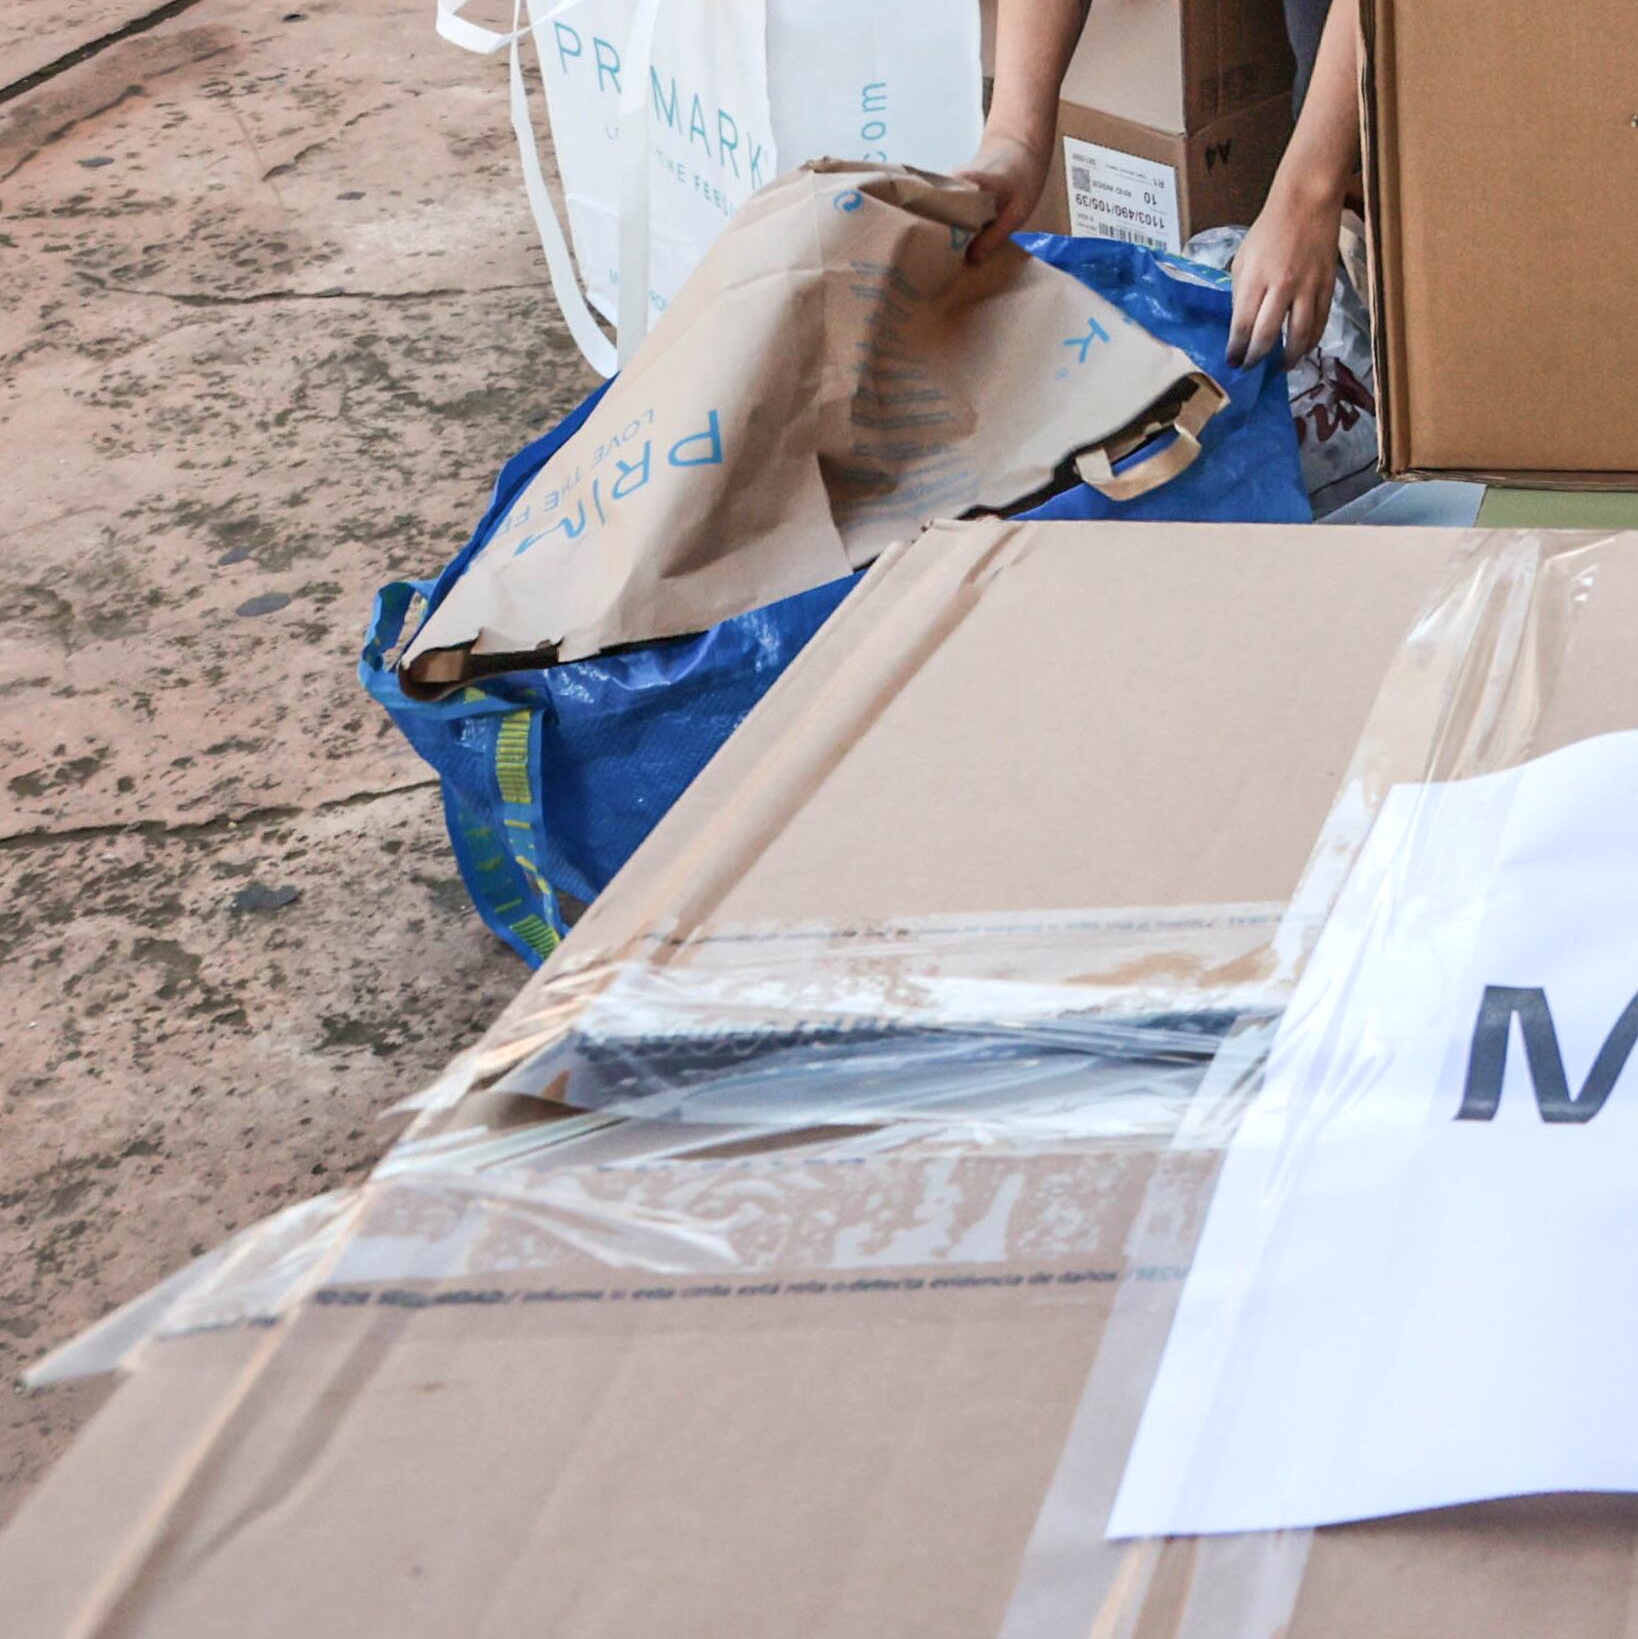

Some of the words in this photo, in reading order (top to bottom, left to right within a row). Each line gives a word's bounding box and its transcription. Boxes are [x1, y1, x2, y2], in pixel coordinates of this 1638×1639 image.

[553, 20, 766, 190] PRMARK
[1074, 192, 1166, 229] 1103/490/105/39
[1143, 191, 1158, 206] 10
[591, 408, 656, 466] LOVE
[544, 466, 582, 513] THE
